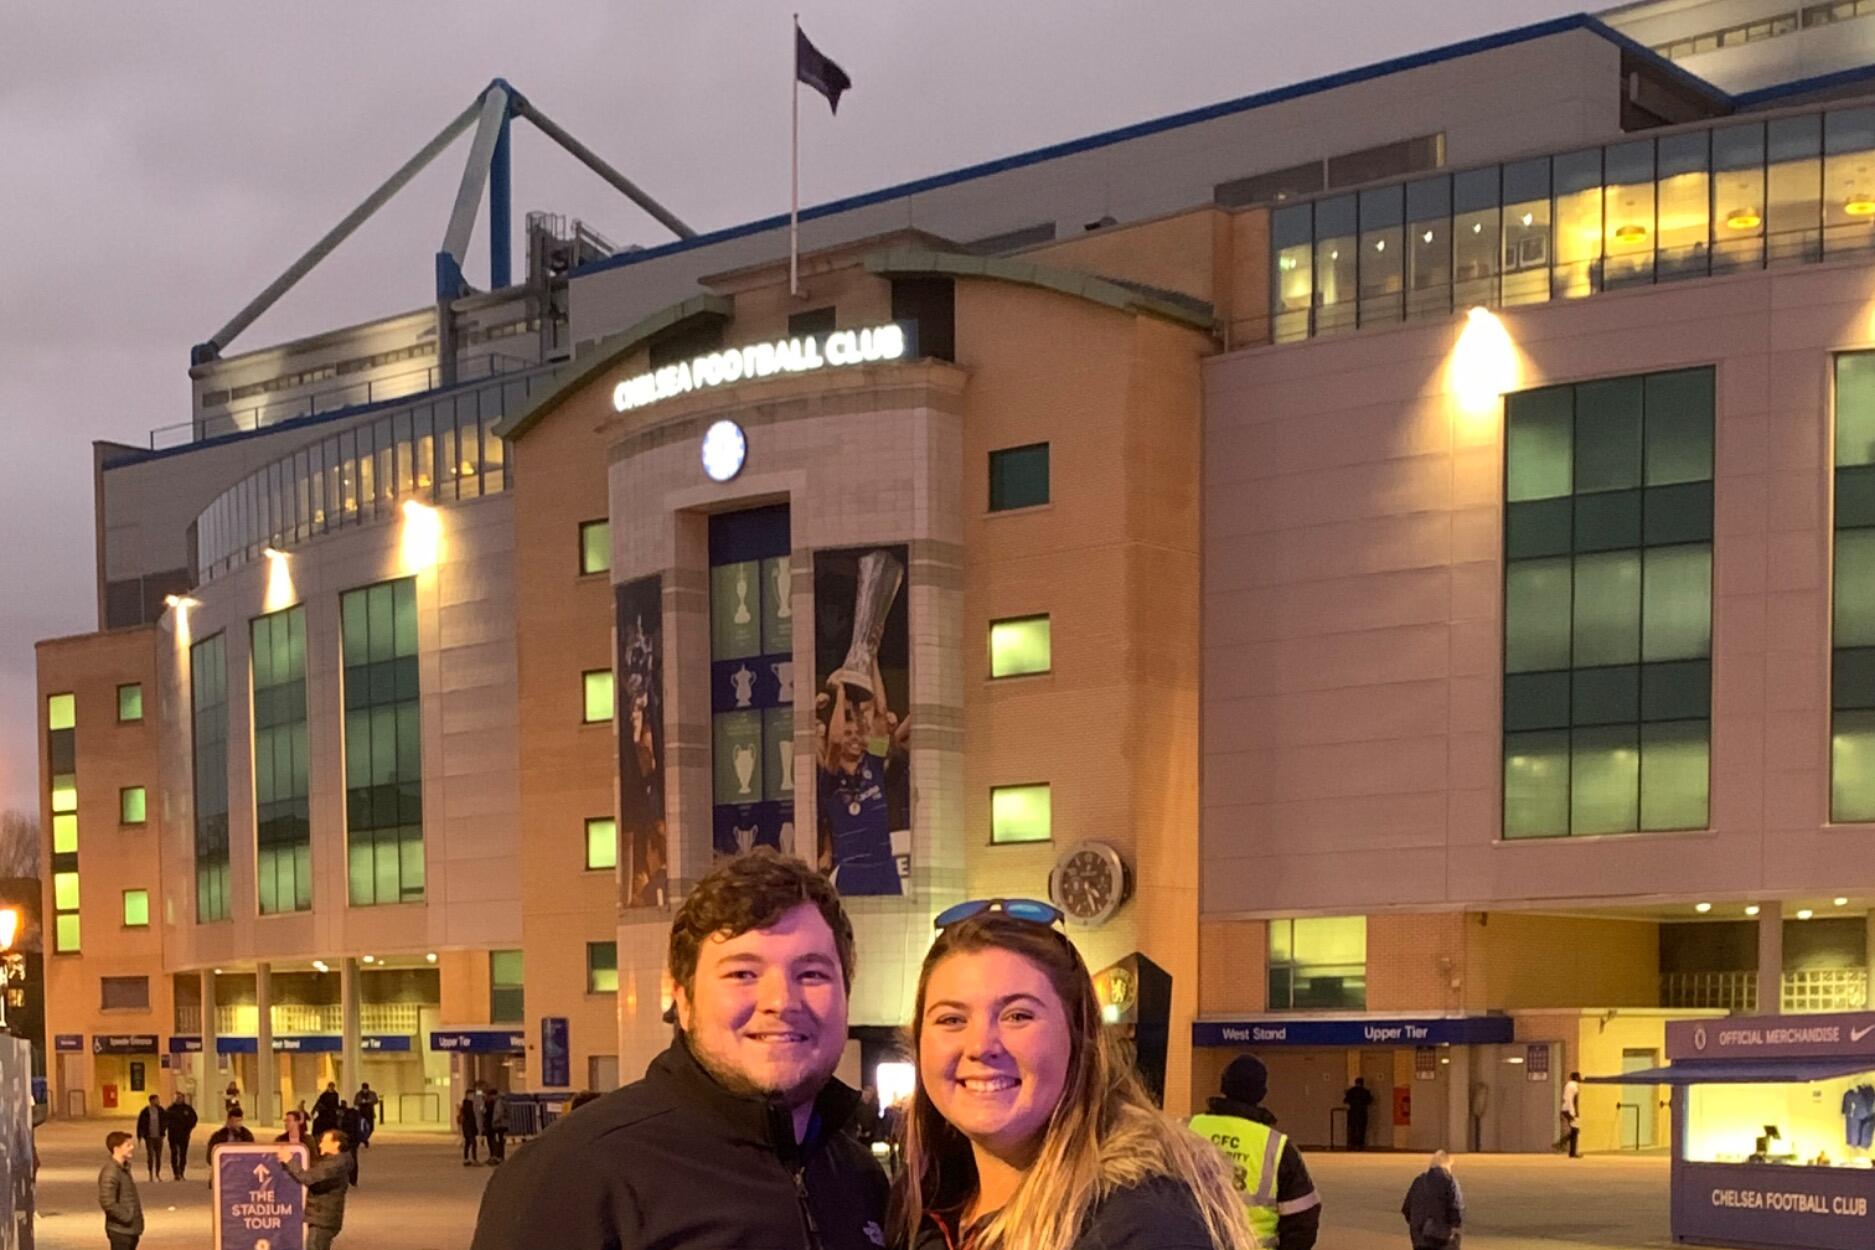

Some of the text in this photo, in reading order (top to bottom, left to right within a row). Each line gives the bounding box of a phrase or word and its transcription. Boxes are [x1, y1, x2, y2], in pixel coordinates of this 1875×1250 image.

[613, 324, 904, 412] CHELSEA FOOTBALL CLUB
[1222, 1027, 1287, 1041] West Stand
[1364, 1025, 1429, 1042] Upper Tier
[1719, 1026, 1840, 1045] OFFICIAL MERCHANDISE
[1211, 1133, 1240, 1149] CFC
[249, 1190, 275, 1203] THE
[1711, 1189, 1867, 1216] CHELSEA FOOTBALL CLUB
[231, 1203, 292, 1217] STADIUM
[243, 1217, 281, 1229] TOUR
